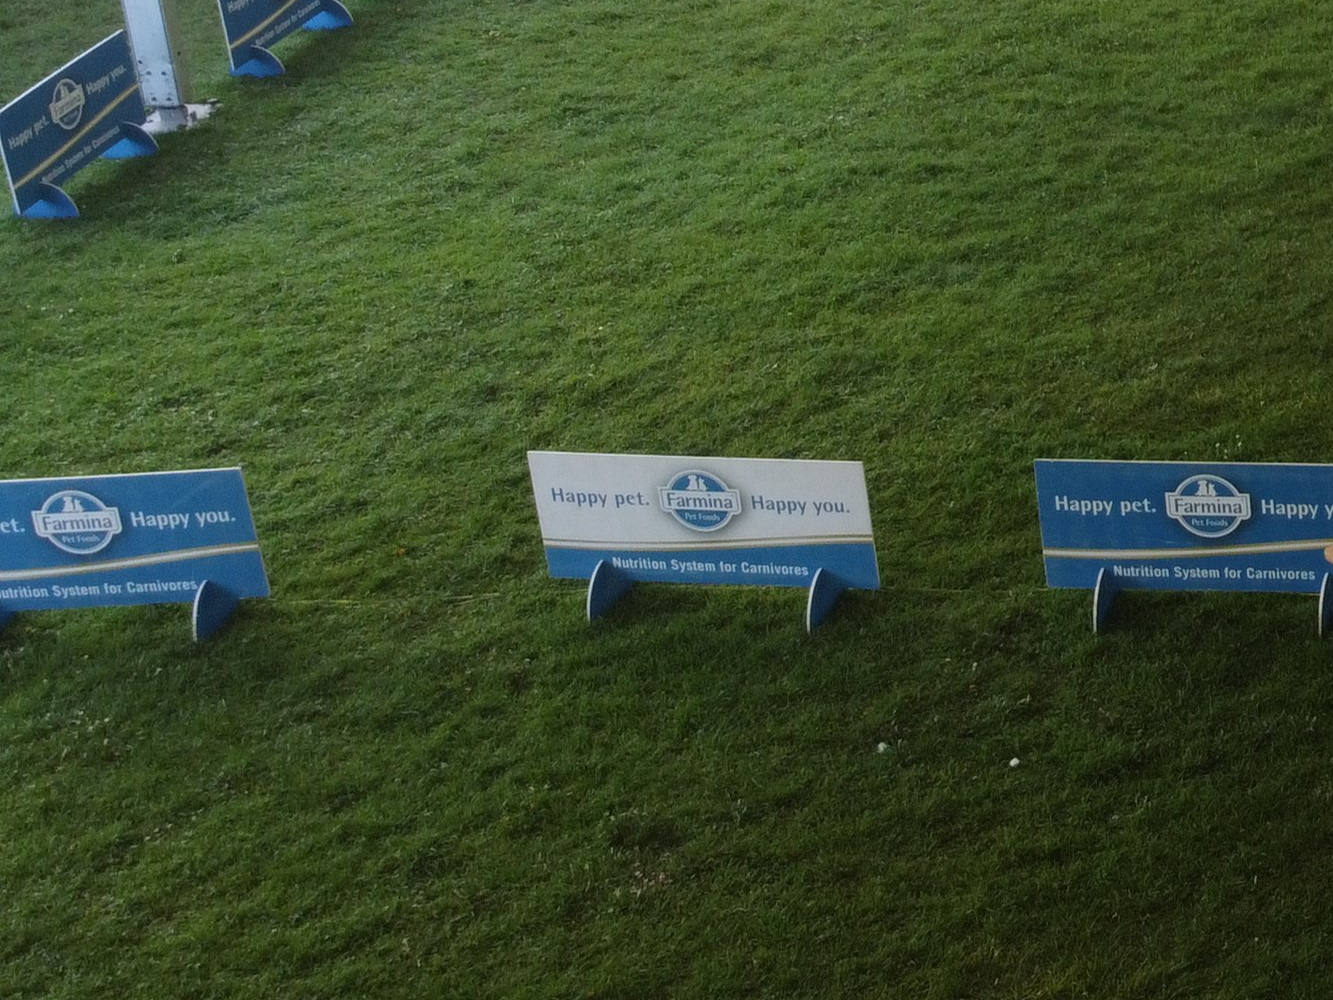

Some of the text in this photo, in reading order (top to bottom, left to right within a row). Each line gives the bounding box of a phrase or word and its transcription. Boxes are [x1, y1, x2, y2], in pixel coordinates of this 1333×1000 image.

[550, 487, 650, 509] Happy pet.
[666, 491, 734, 510] Farmina
[751, 495, 850, 517] Happy you.
[1054, 495, 1157, 517] Happy pet.
[1173, 497, 1243, 516] Farmina
[684, 512, 697, 521] Pet
[1261, 499, 1319, 519] Happy
[0, 519, 26, 533] et.
[41, 515, 114, 532] Farmina
[130, 510, 237, 530] Happy you.
[1191, 517, 1204, 527] Pet
[611, 556, 809, 576] Nutrition System for Carnivores
[1112, 564, 1316, 581] Nutrition System for Carnivores
[0, 579, 199, 599] utrition System for Carnivores
